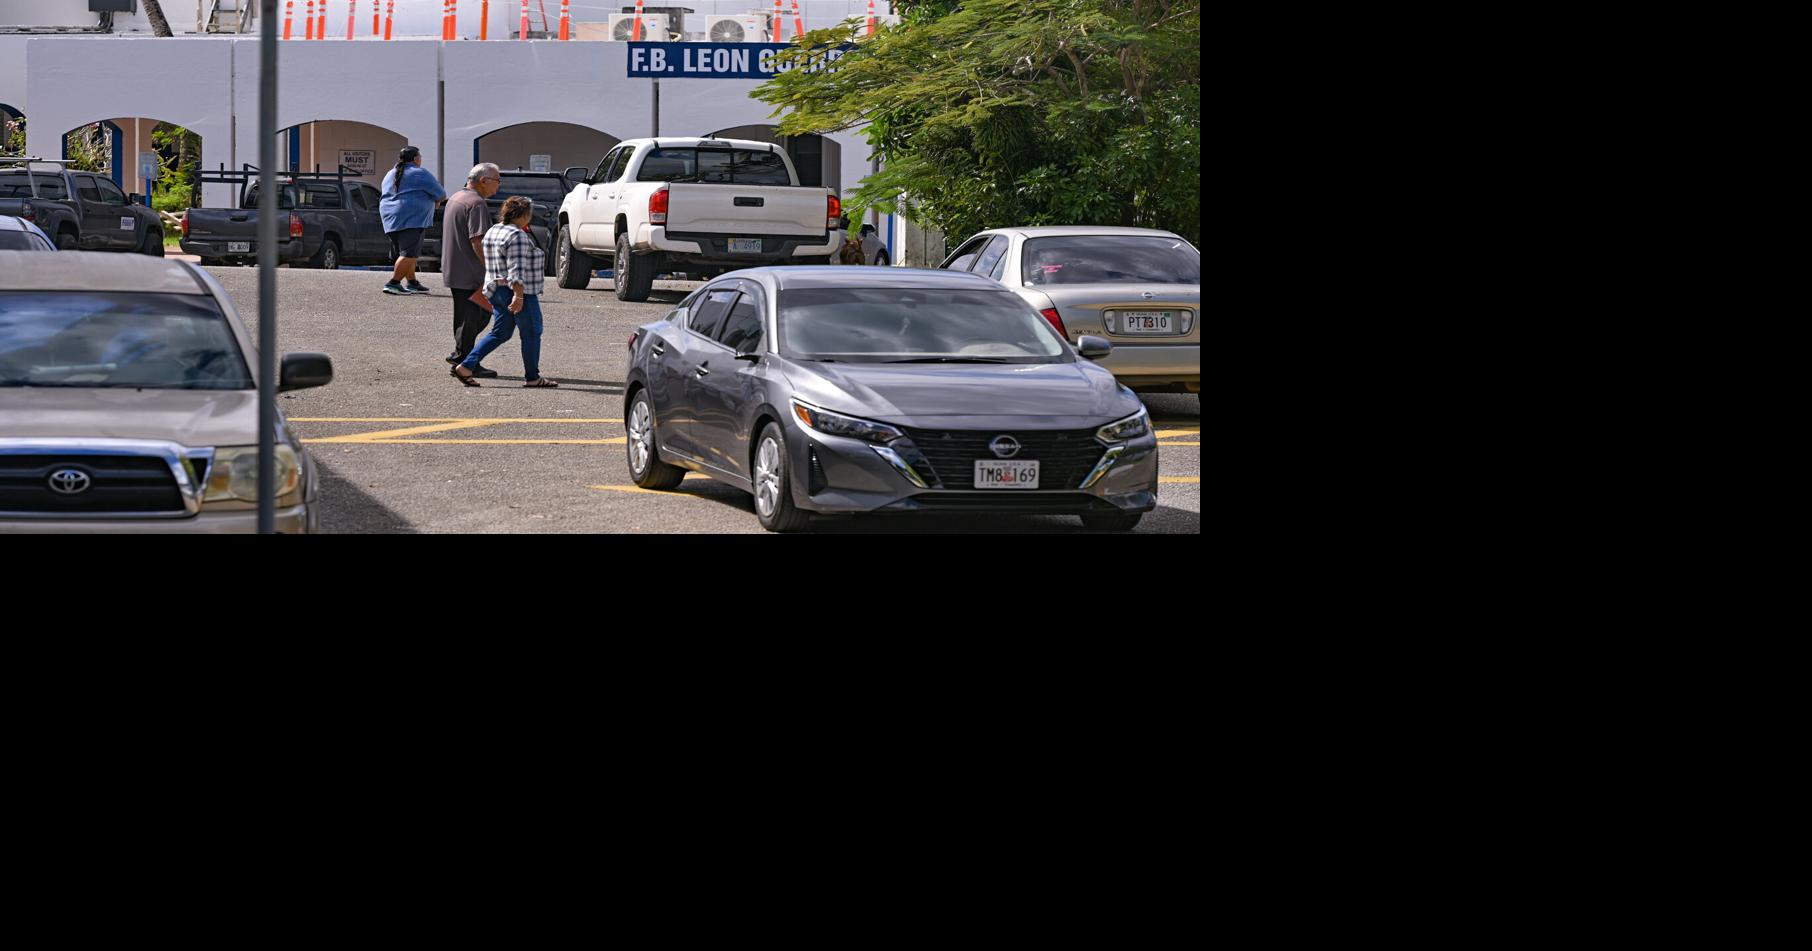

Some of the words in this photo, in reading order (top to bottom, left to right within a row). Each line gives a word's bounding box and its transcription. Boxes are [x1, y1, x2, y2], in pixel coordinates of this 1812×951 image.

[631, 48, 675, 72] F.B.
[683, 48, 750, 73] LEON
[1128, 316, 1167, 329] PT7310
